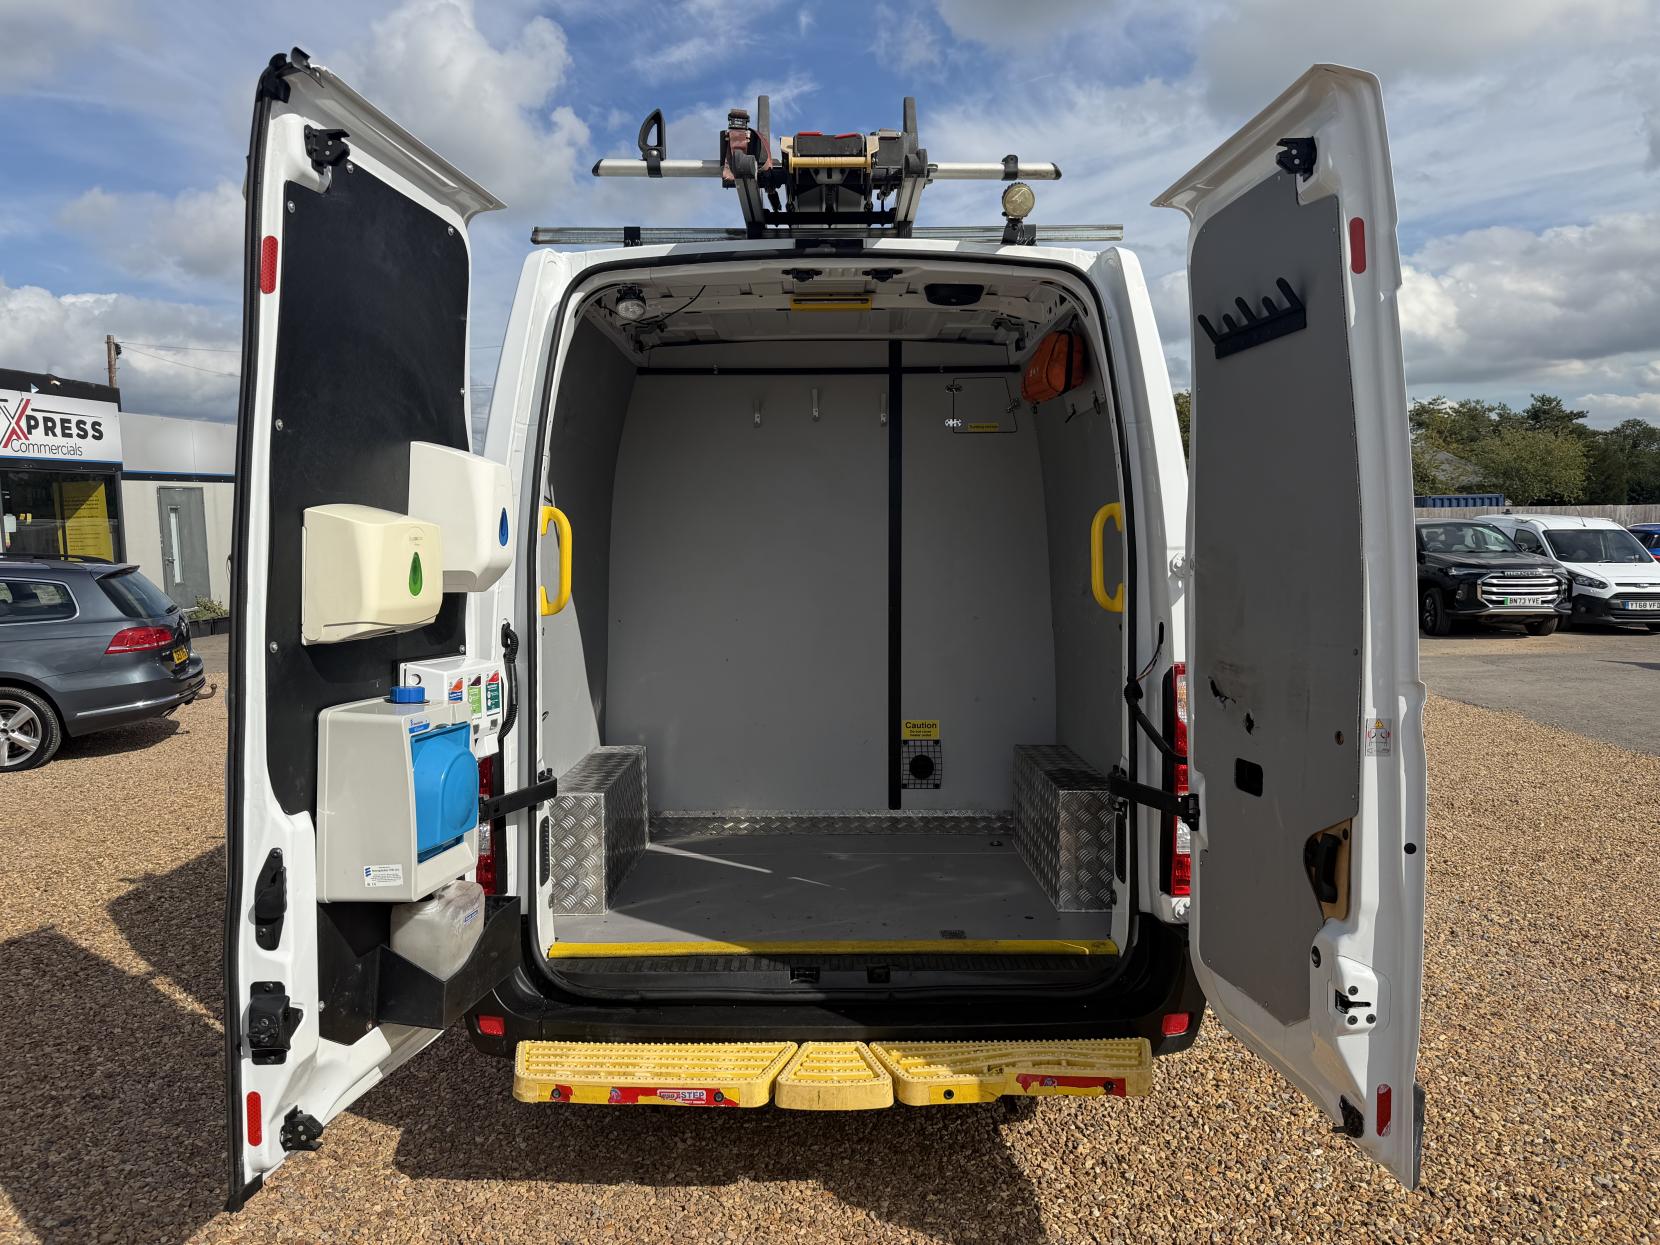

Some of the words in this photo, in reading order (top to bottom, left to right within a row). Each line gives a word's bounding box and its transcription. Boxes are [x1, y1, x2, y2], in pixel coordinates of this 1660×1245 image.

[10, 438, 83, 456] Commercials
[1509, 597, 1526, 605] BN73
[905, 721, 937, 729] Caution
[681, 1091, 705, 1099] STEP
